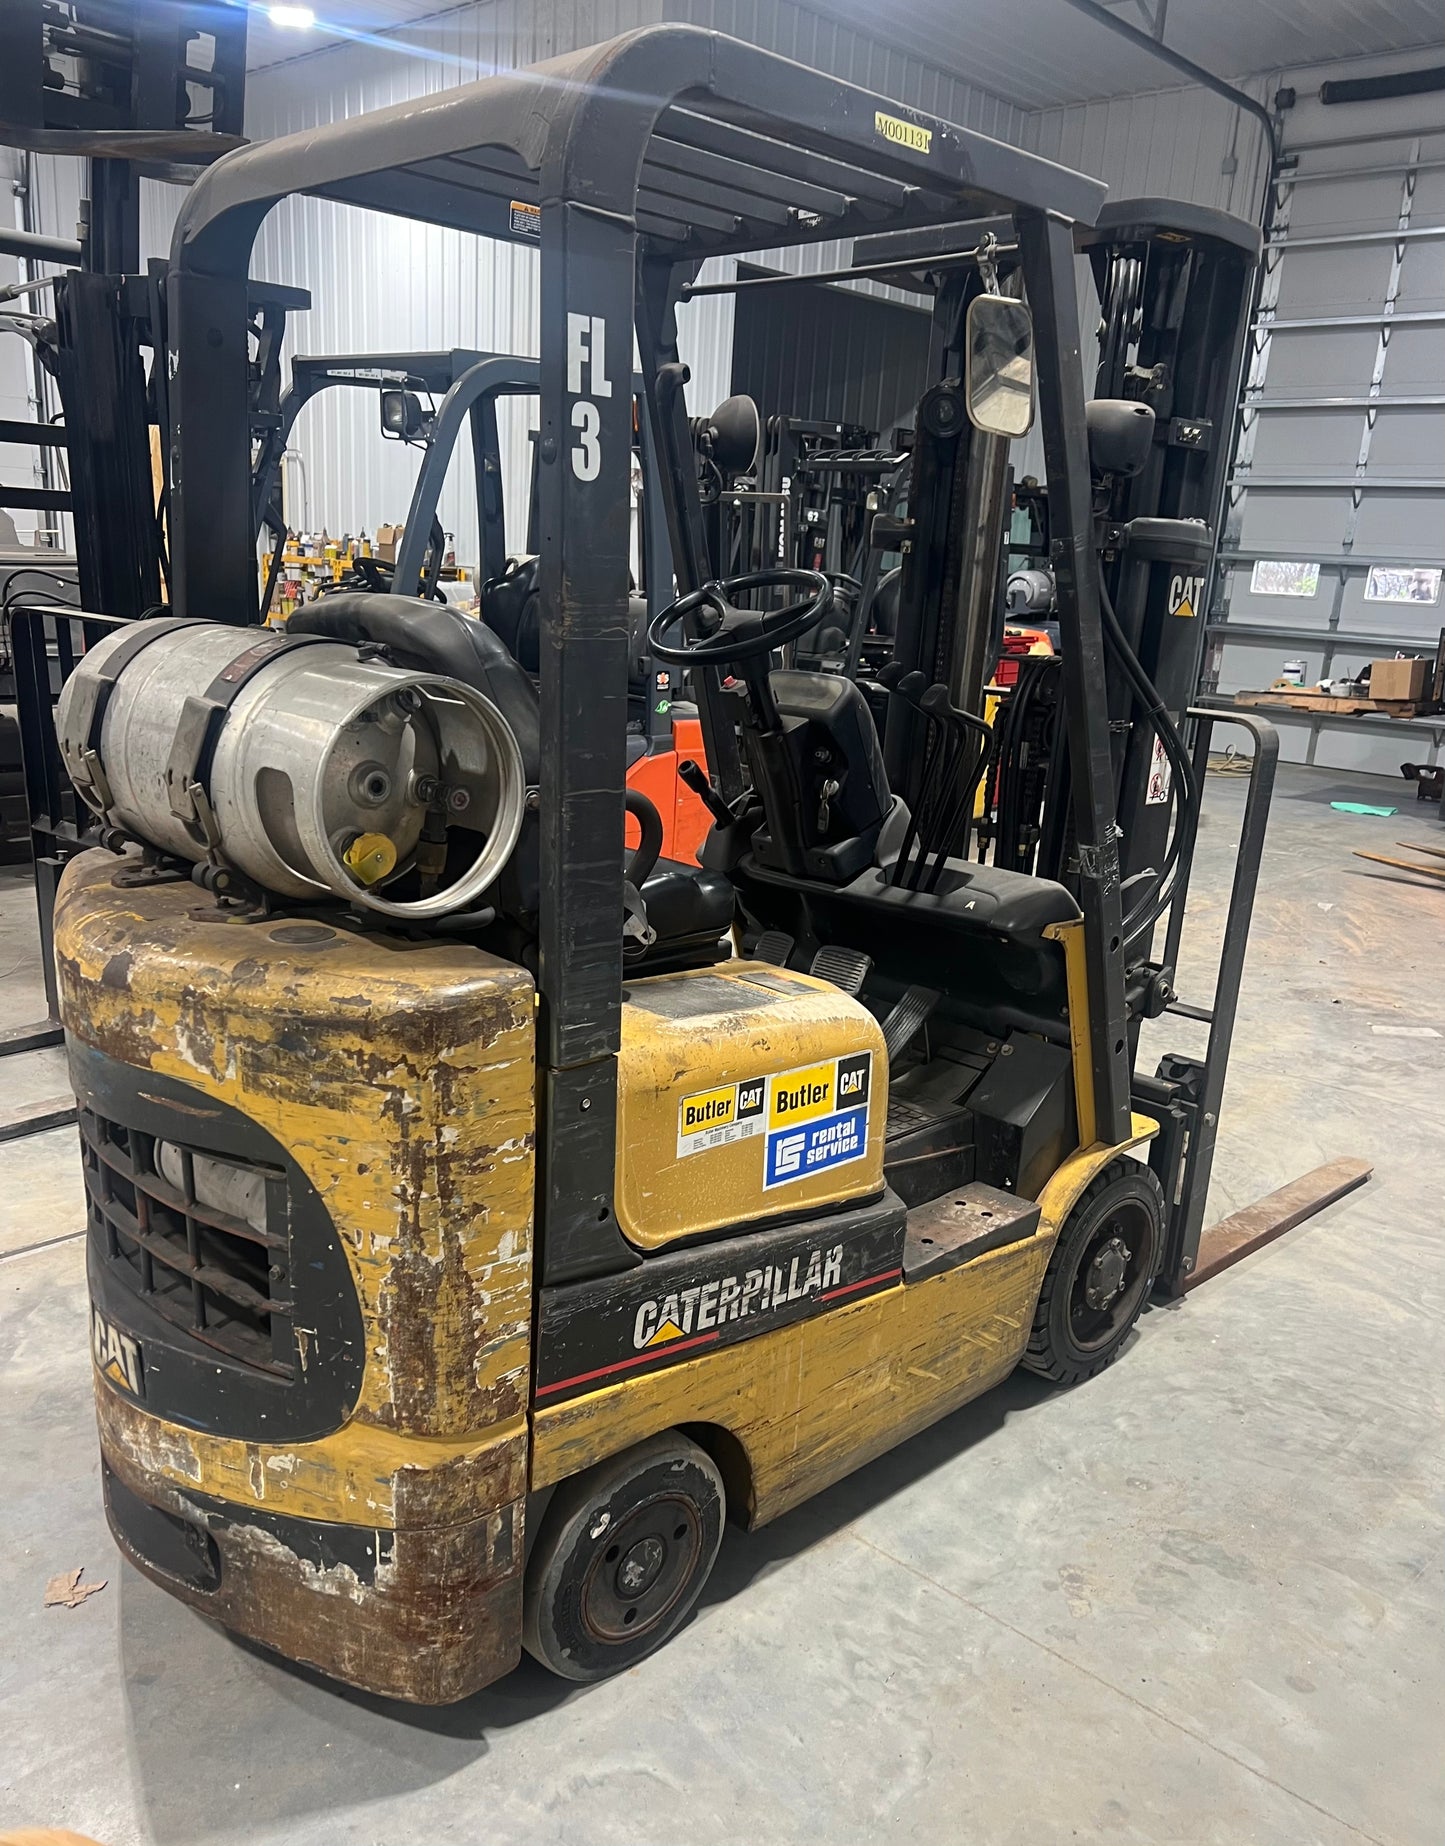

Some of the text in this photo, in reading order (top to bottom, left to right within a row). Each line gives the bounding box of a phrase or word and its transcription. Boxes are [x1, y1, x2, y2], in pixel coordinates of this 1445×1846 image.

[567, 312, 613, 398] FL
[571, 400, 602, 482] 3
[807, 511, 819, 522] 62
[1168, 575, 1205, 617] CAT
[686, 1087, 763, 1126] Butler CAT
[777, 1069, 867, 1113] Butler CAT
[806, 1135, 859, 1165] service
[811, 1117, 856, 1147] rental
[633, 1243, 844, 1349] CATERPILLAR
[94, 1310, 140, 1396] CAT
